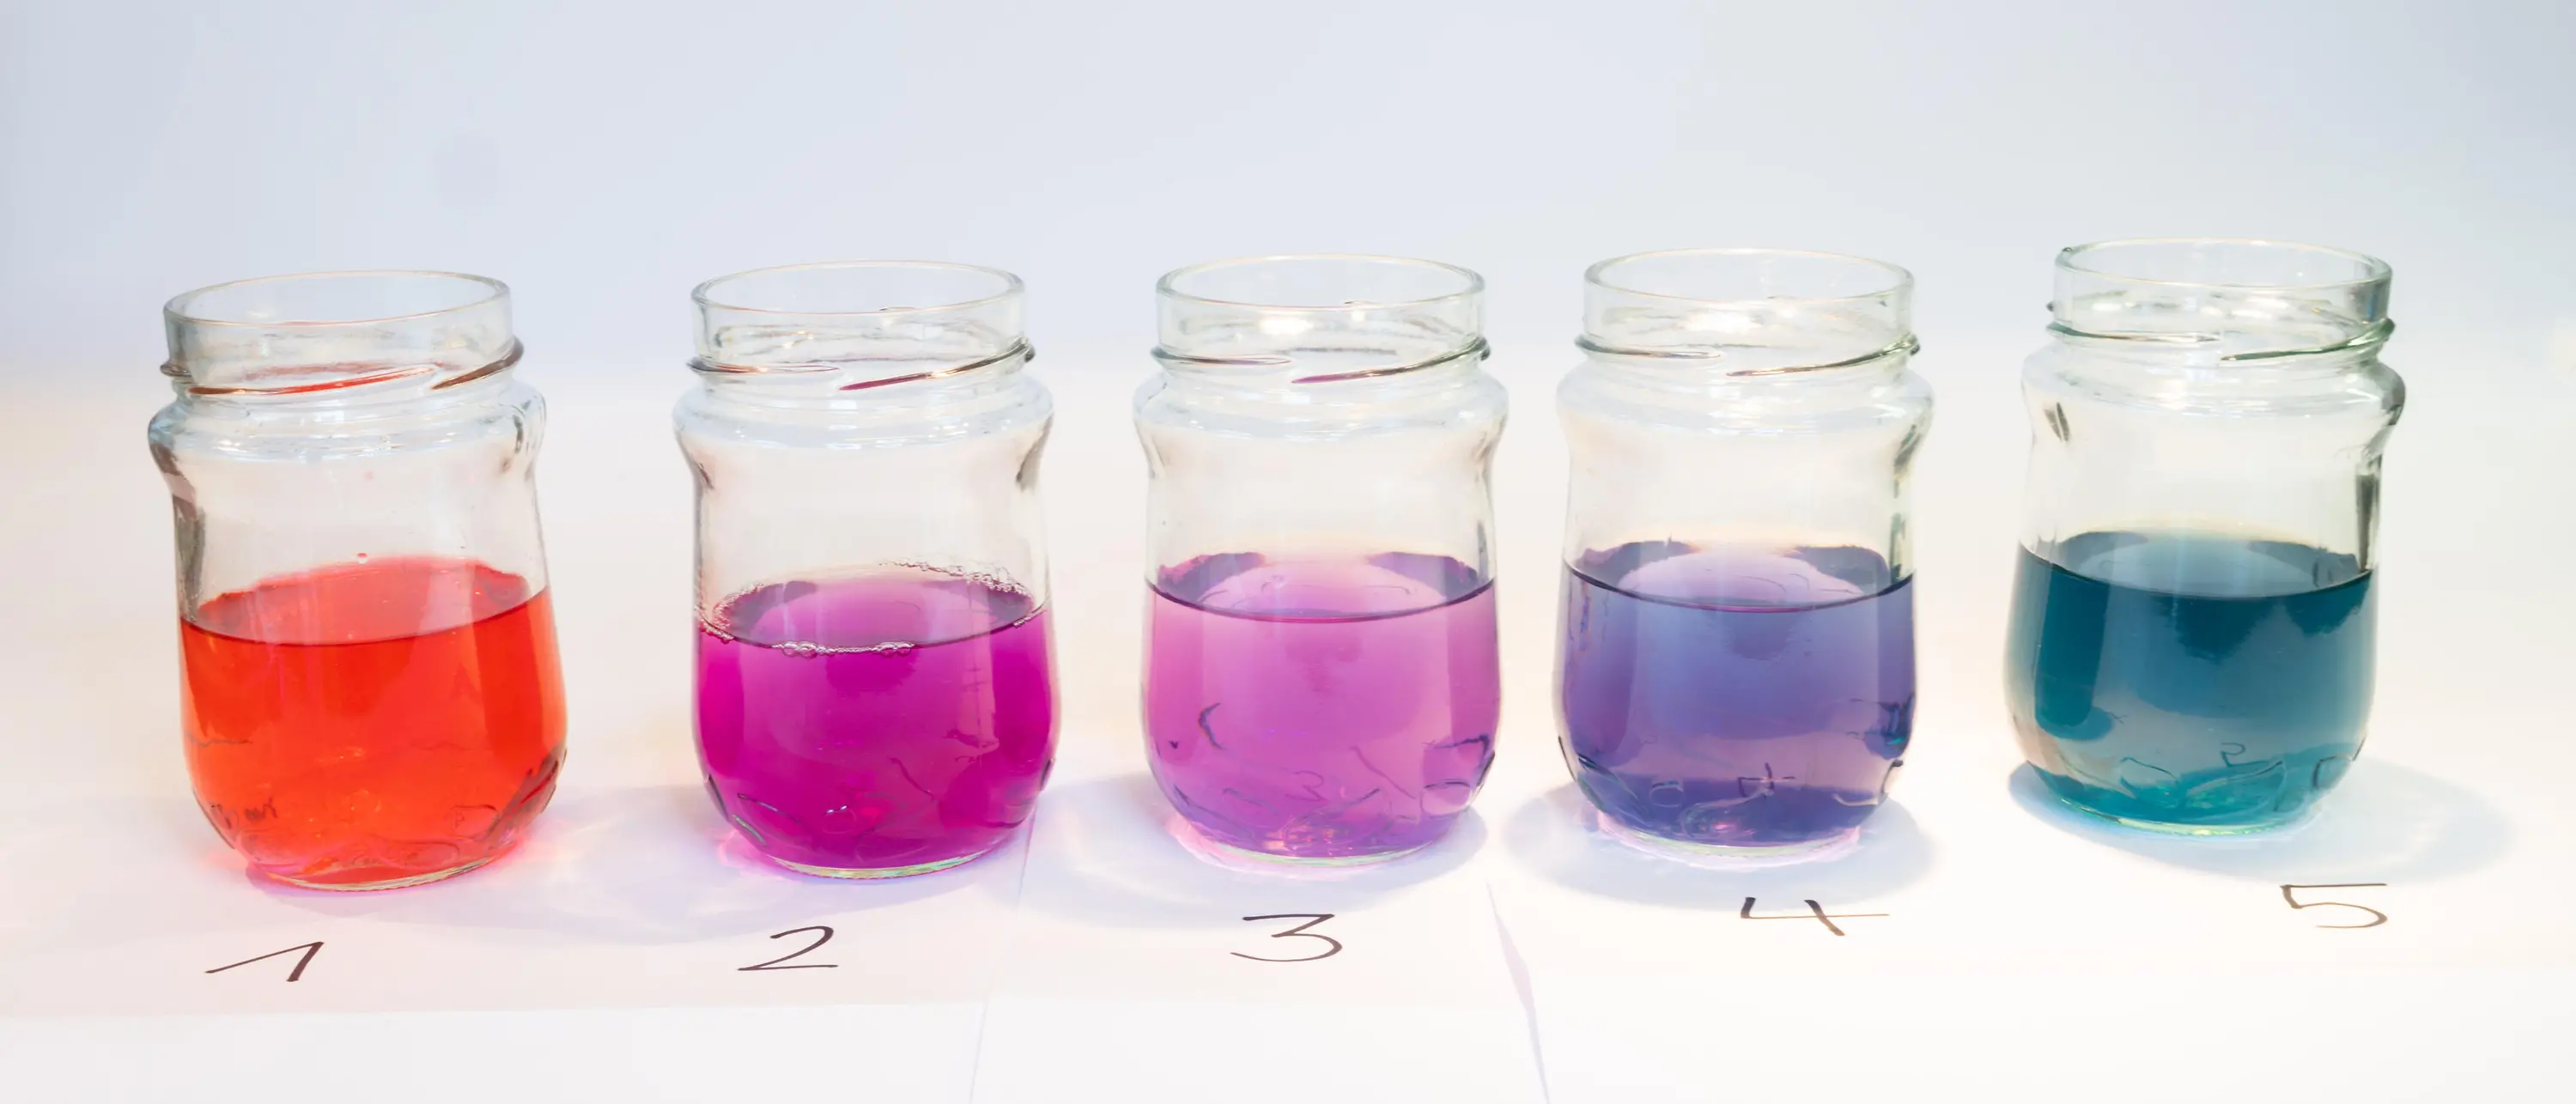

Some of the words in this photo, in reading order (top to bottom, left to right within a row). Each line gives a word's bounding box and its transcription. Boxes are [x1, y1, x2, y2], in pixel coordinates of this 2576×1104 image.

[1741, 896, 1891, 937] 4
[2280, 883, 2388, 929] 5
[738, 925, 839, 972] 2
[1230, 913, 1343, 962] 3
[205, 941, 325, 983] 1
